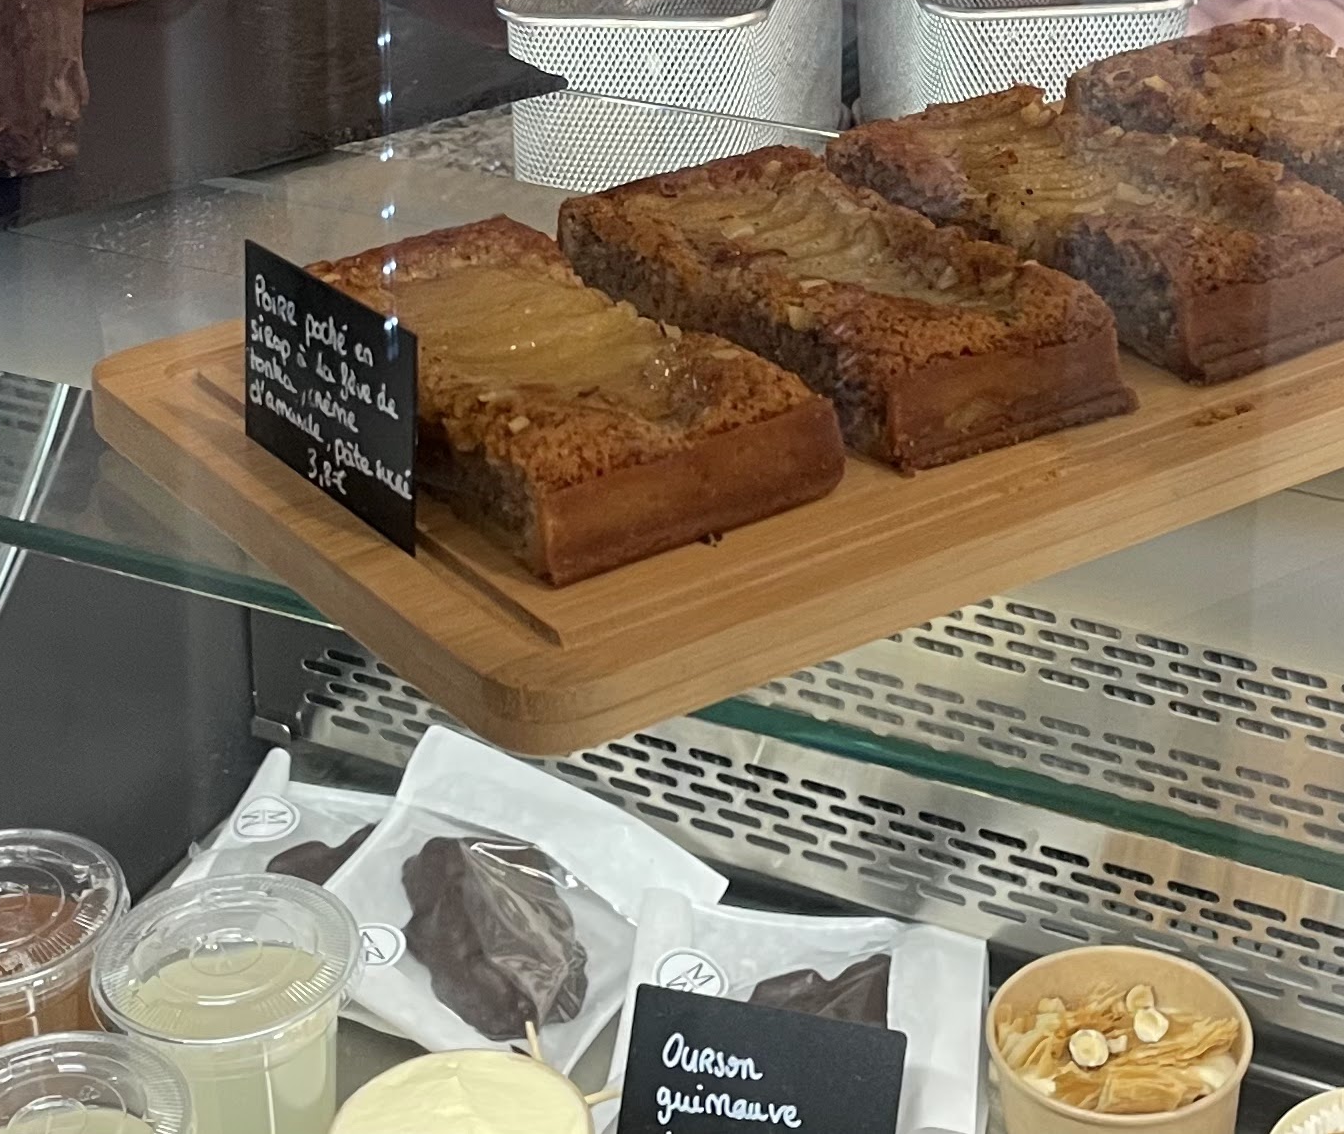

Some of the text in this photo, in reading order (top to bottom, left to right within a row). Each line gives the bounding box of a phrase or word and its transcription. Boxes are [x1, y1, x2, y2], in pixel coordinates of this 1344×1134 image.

[306, 313, 348, 356] poché
[355, 343, 374, 367] en
[316, 352, 336, 383] la
[377, 383, 399, 420] de
[662, 1032, 763, 1080] Ourson
